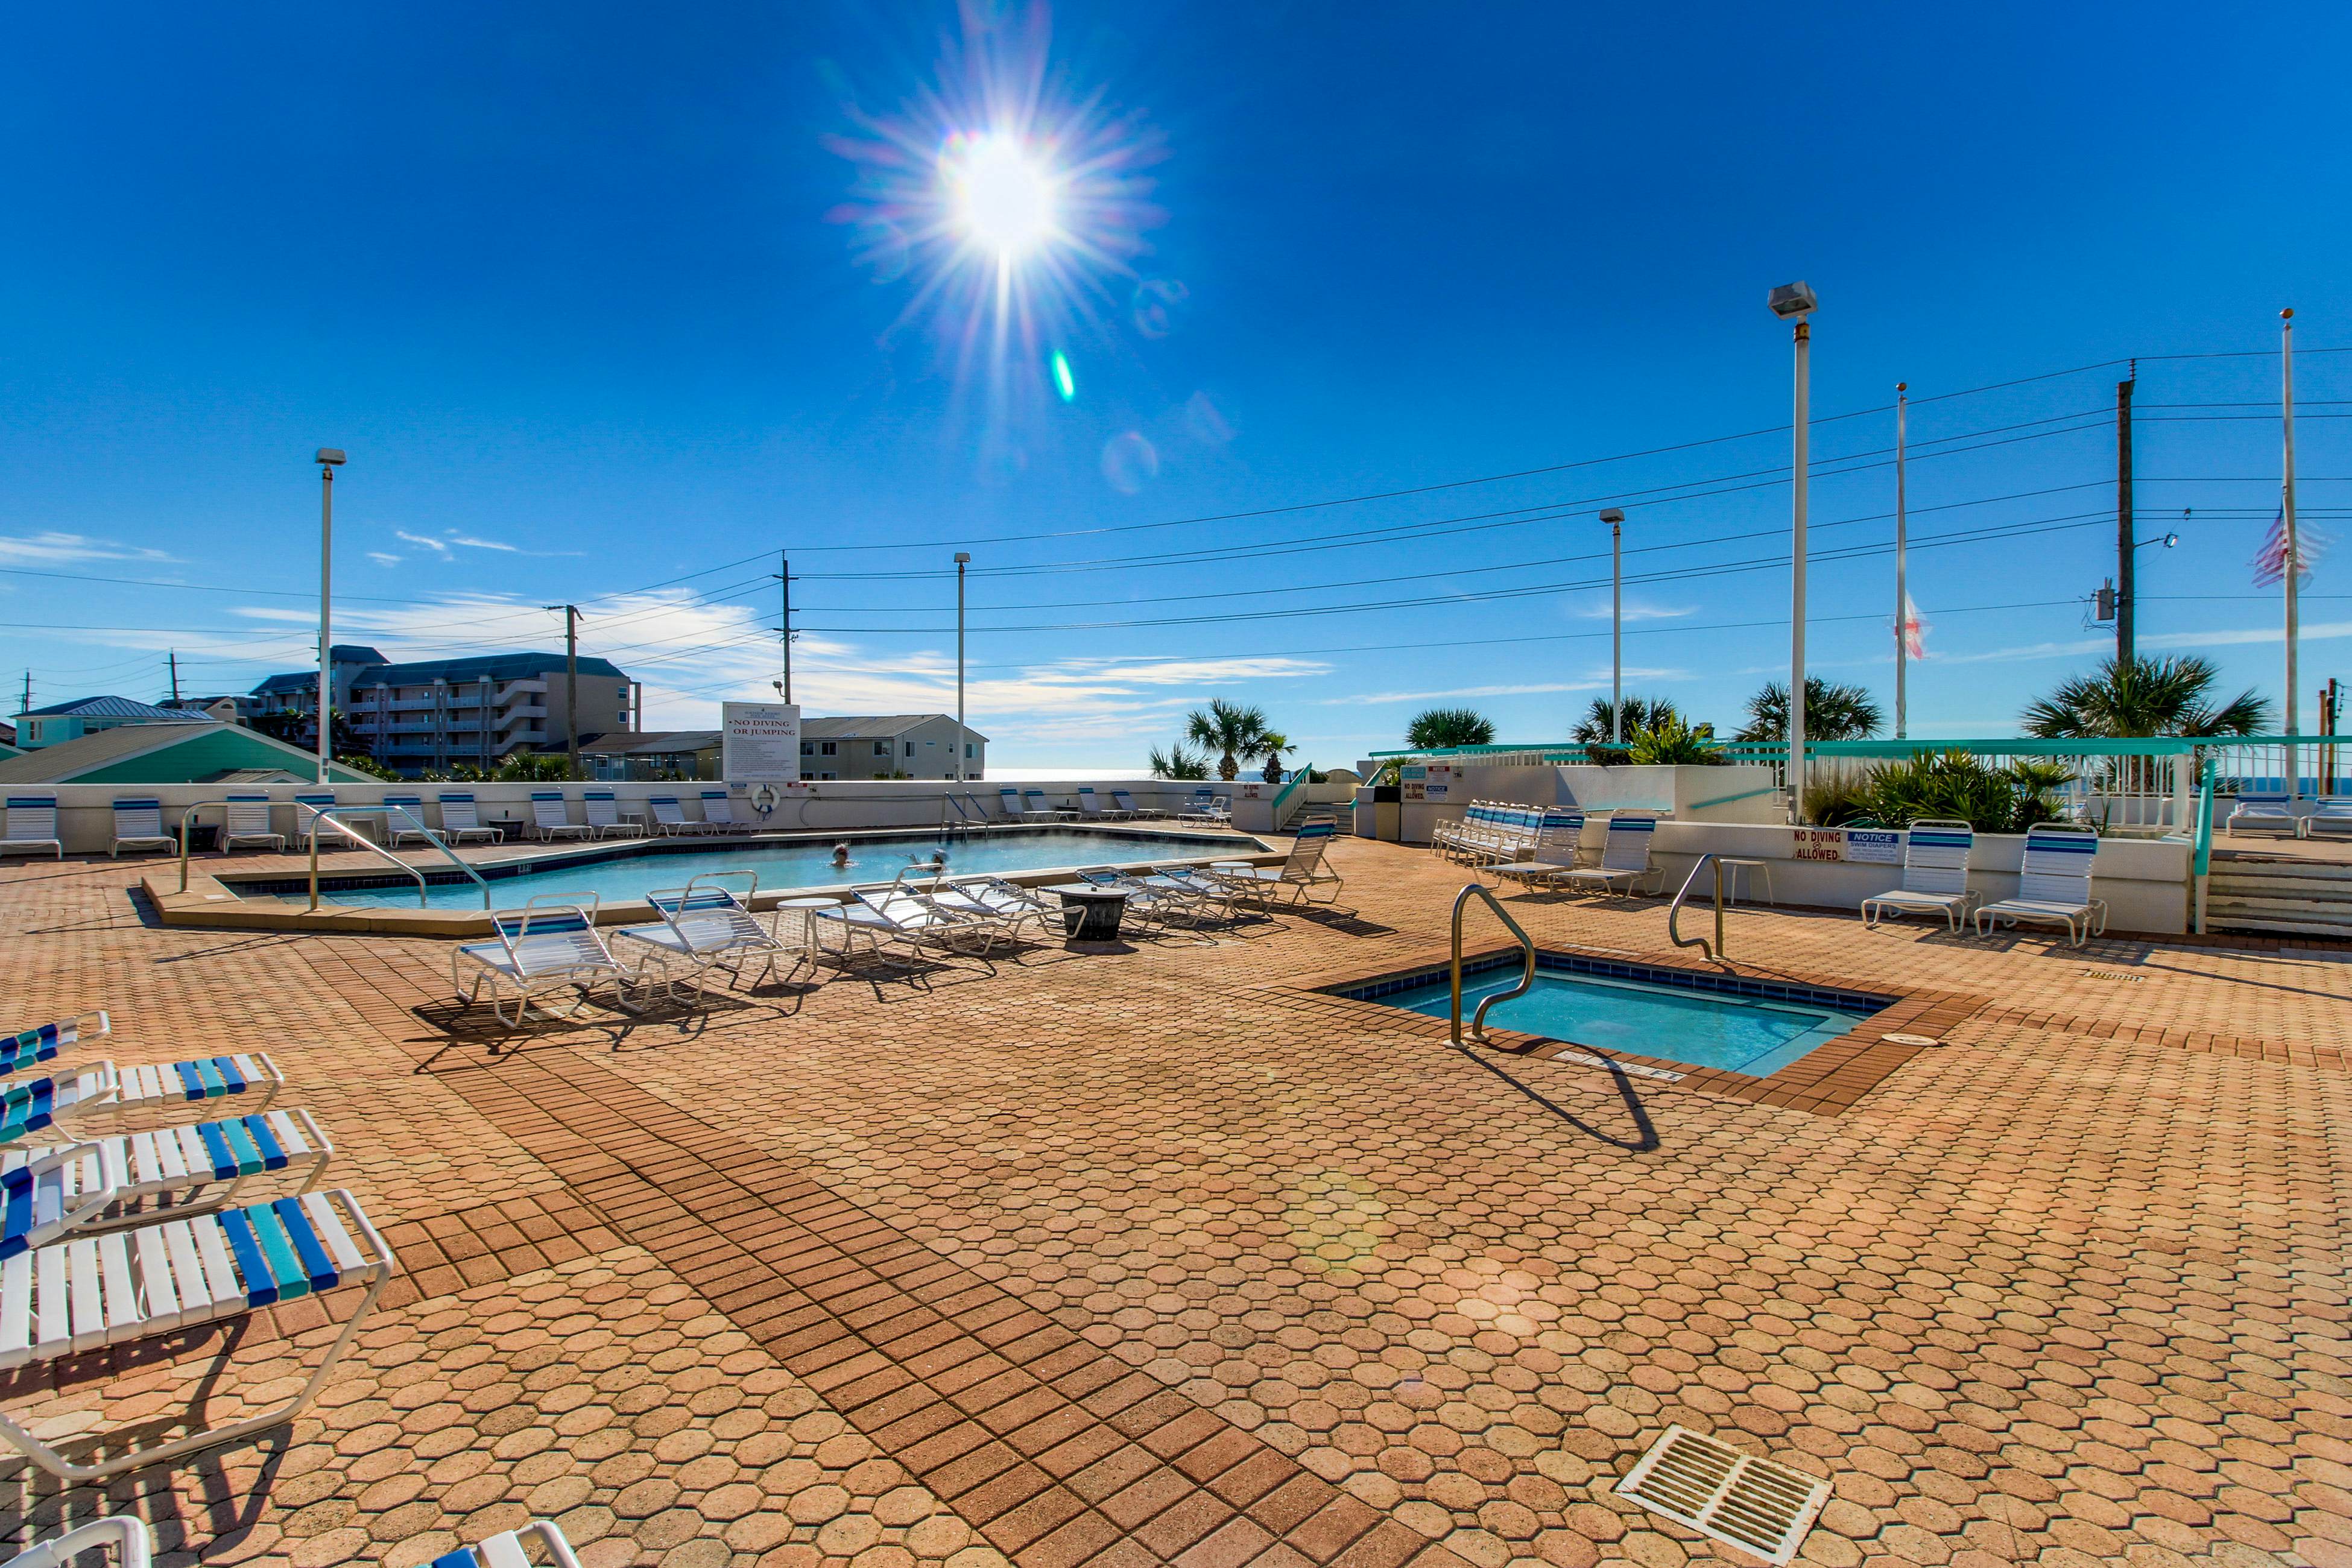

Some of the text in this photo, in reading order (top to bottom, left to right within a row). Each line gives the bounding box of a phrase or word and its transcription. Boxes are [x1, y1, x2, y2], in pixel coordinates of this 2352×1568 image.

[1794, 831, 1841, 842] NO DIVING
[1854, 833, 1893, 842] NOTICE
[1797, 849, 1838, 860] ALLOWED
